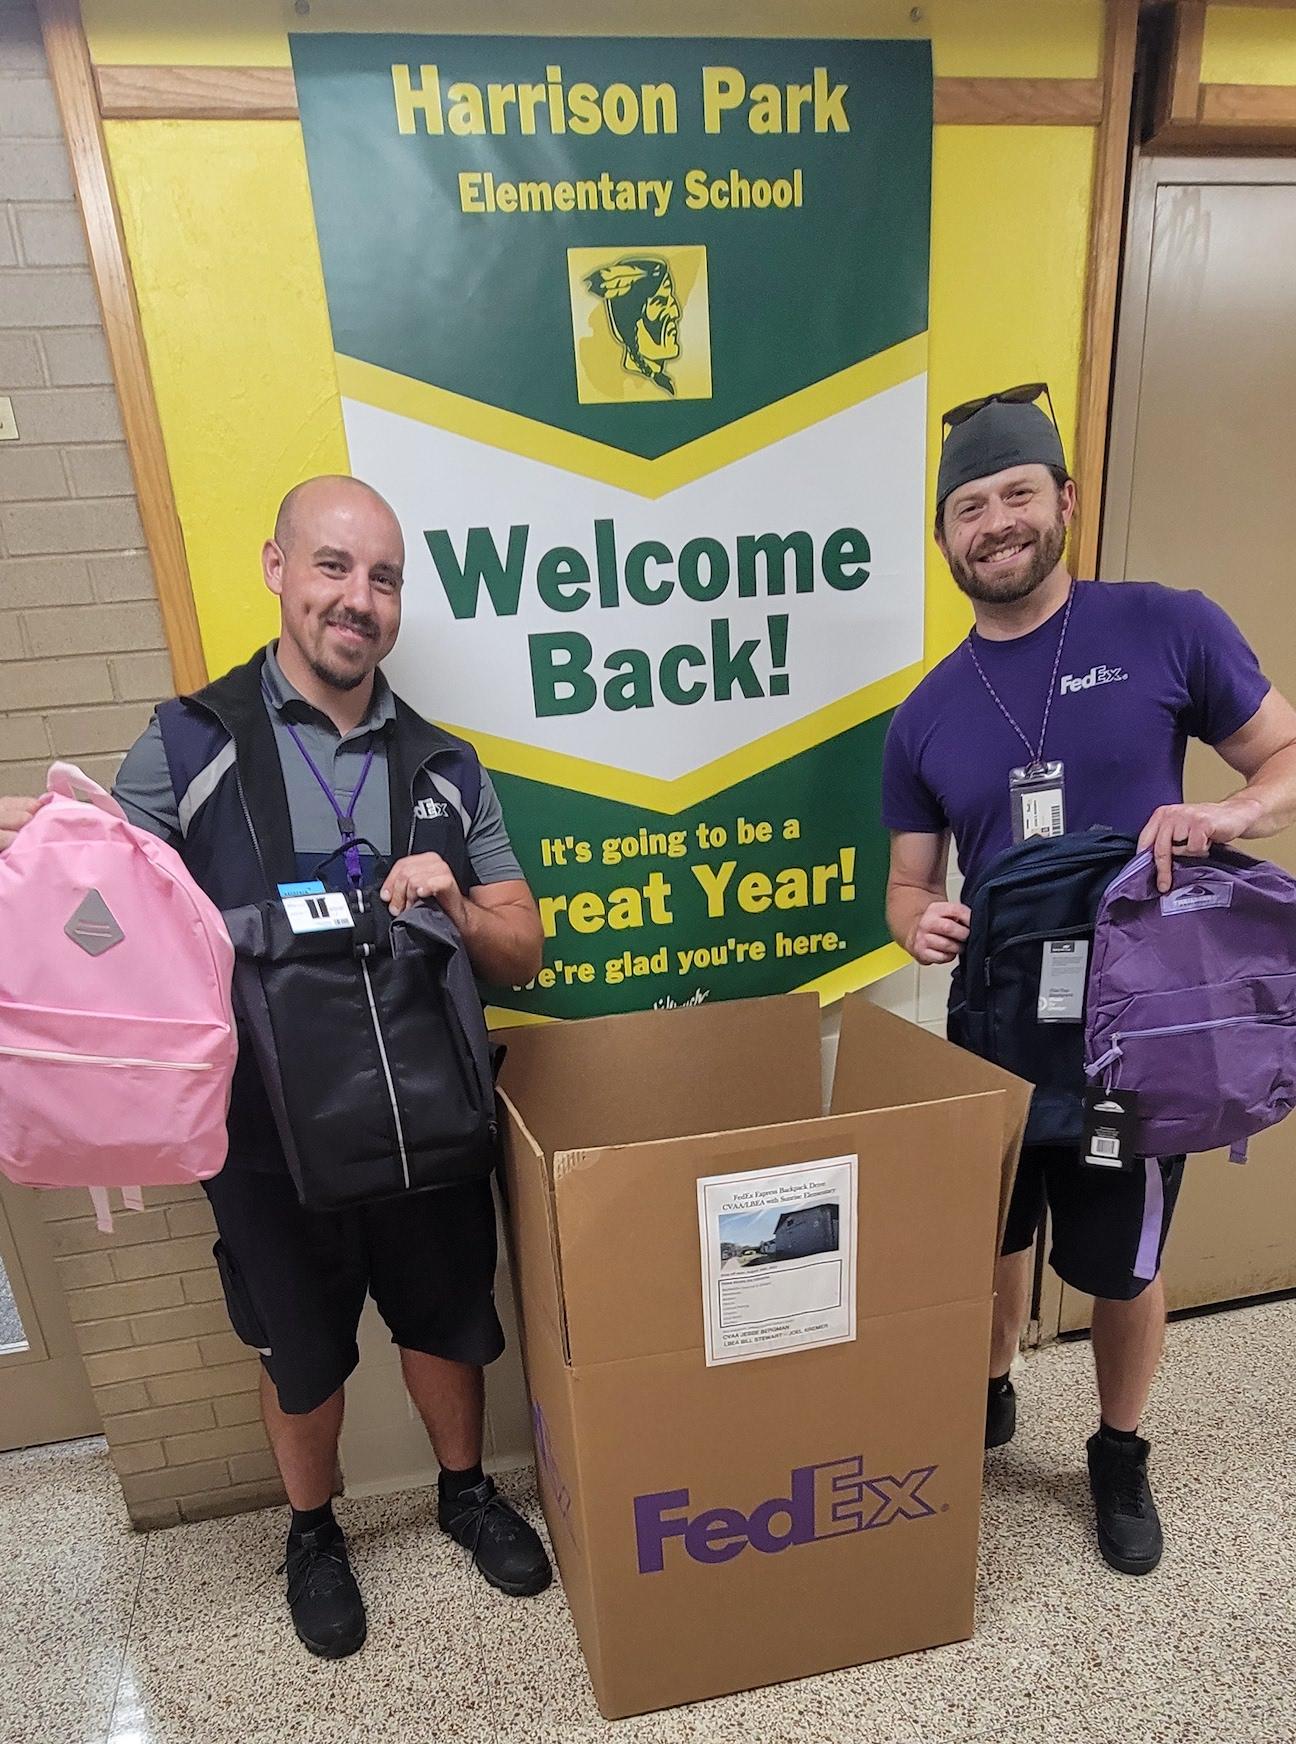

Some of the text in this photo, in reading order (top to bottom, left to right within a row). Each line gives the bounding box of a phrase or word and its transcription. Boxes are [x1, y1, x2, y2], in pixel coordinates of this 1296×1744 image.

[391, 63, 851, 136] Harrison Park
[457, 168, 804, 218] Elementary School
[422, 518, 872, 621] Welcome
[527, 612, 791, 719] Back!
[1060, 664, 1128, 696] FedEx
[413, 797, 449, 820] dEx
[540, 816, 801, 867] It's going to be a
[537, 847, 857, 939] reat Year!
[511, 930, 847, 992] e're glad you're here.
[632, 1455, 940, 1575] FedEx
